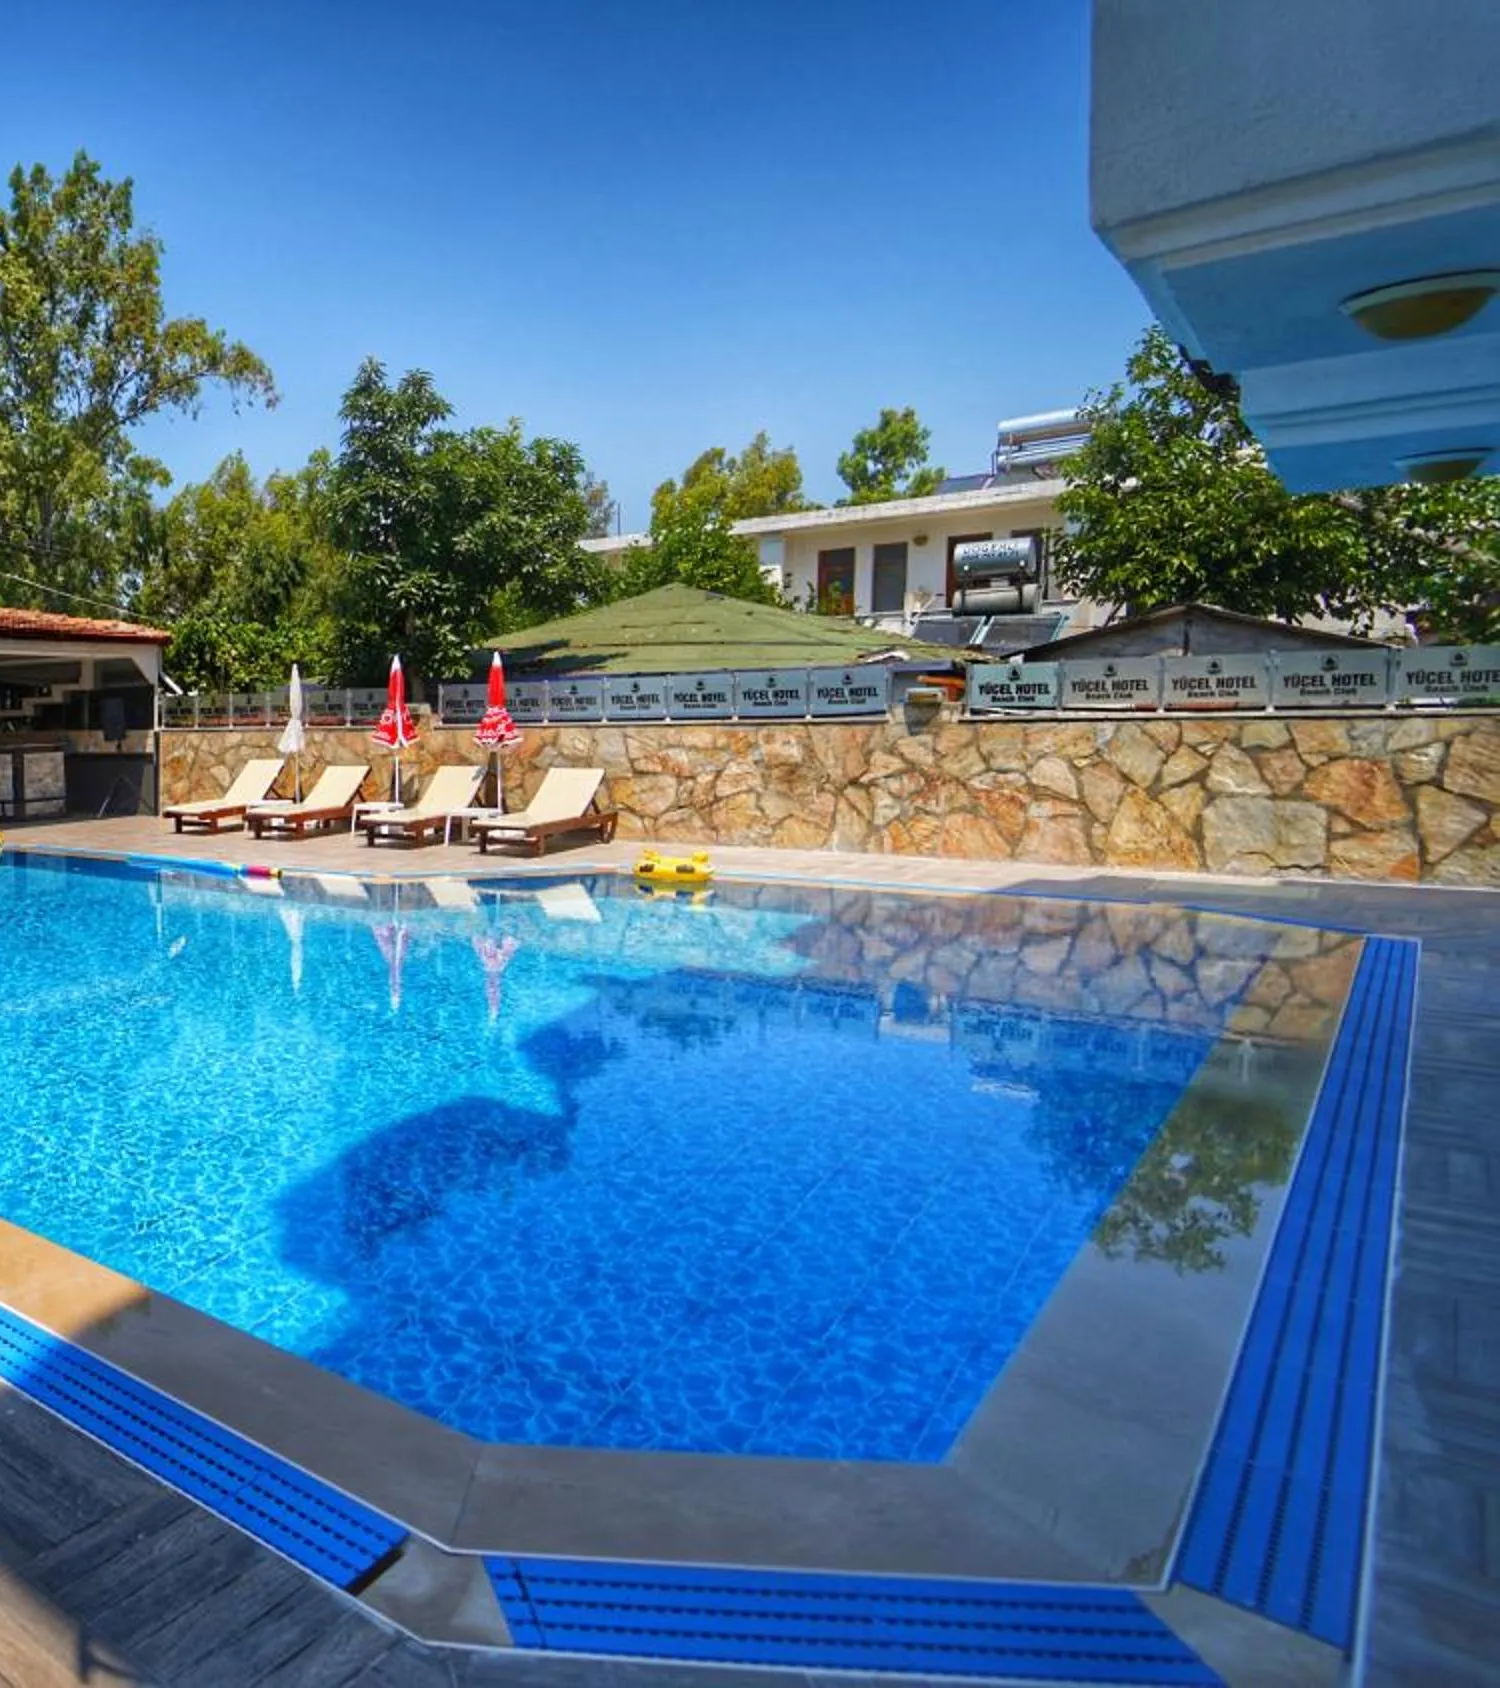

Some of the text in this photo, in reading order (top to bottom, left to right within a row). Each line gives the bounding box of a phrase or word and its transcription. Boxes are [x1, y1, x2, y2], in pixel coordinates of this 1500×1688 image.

[1172, 675, 1257, 690] YÜCEL HOTEL
[1283, 672, 1376, 688] YÜCEL HOTEL
[1406, 669, 1454, 685] YÜCEL
[817, 687, 879, 699] YÜCEL HOTEL
[978, 682, 1051, 695] YÜCEL HOTEL
[1071, 678, 1149, 693] YÜCEL HOTEL
[743, 688, 800, 701] YÜCEL HOTEL
